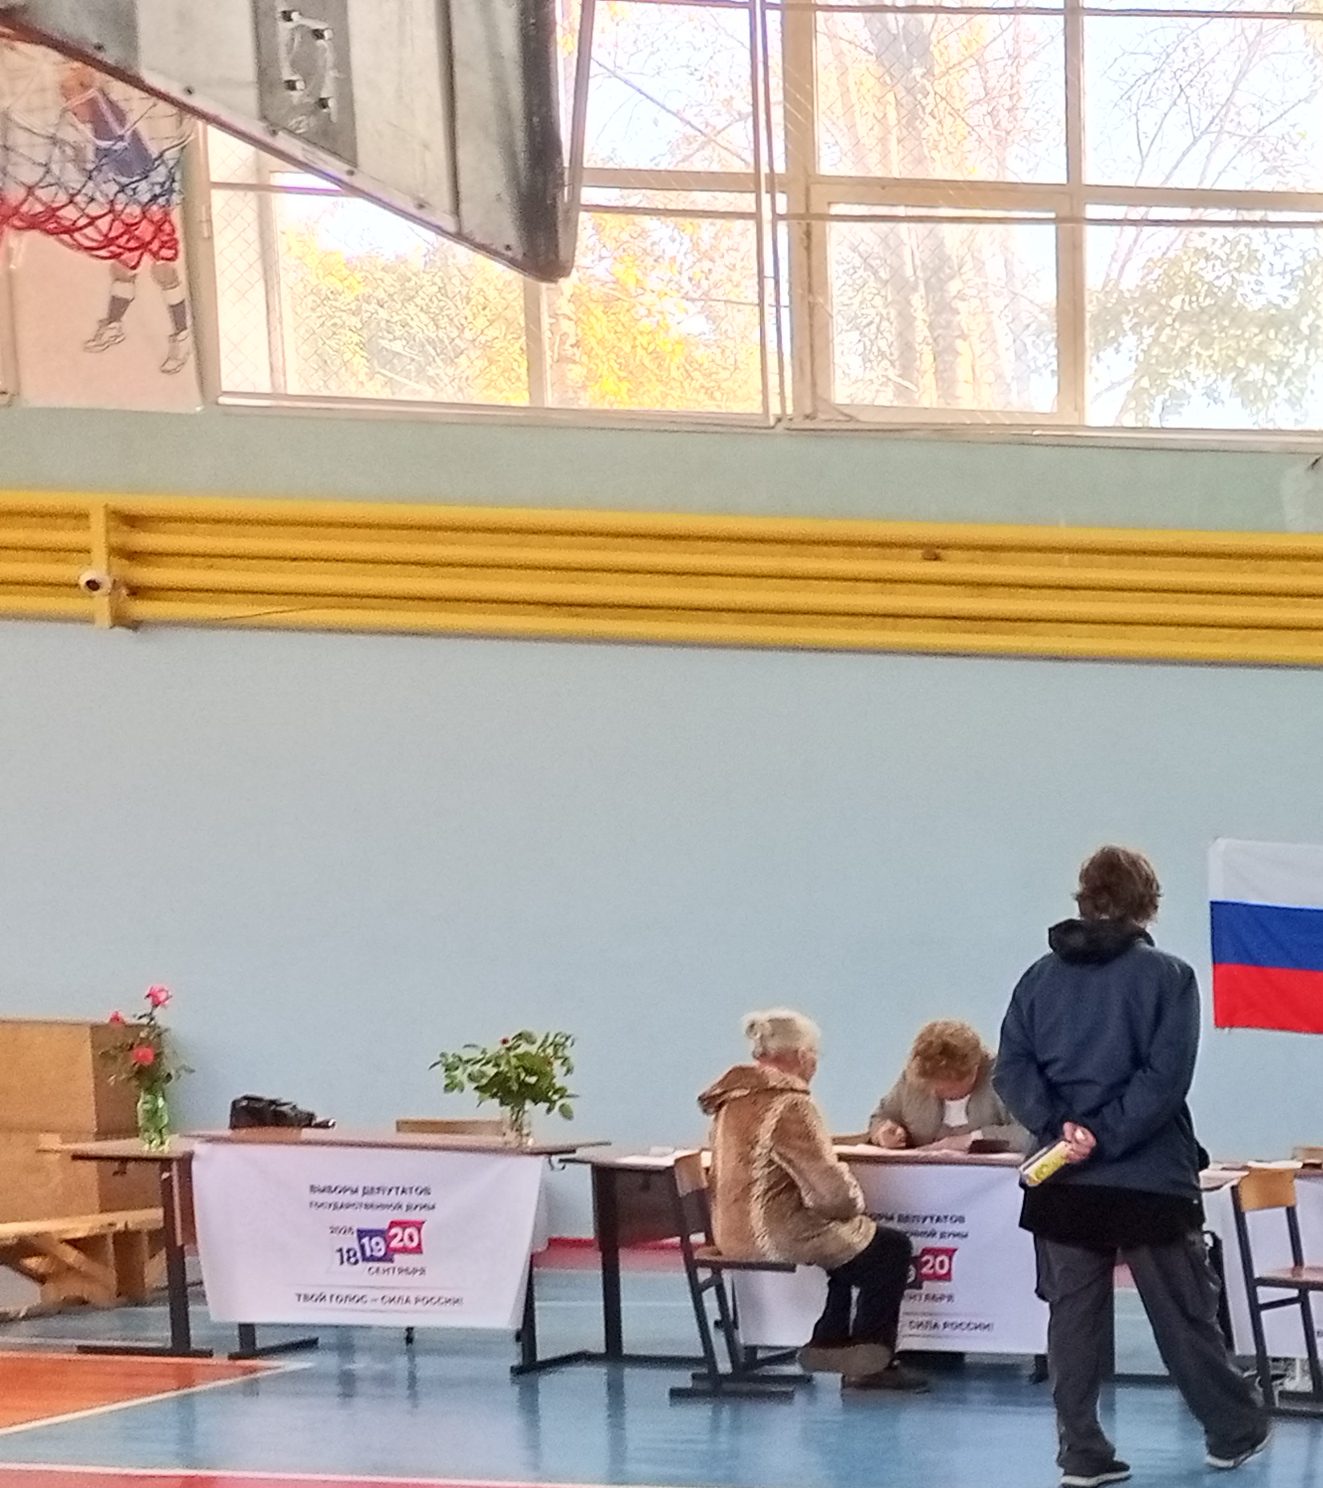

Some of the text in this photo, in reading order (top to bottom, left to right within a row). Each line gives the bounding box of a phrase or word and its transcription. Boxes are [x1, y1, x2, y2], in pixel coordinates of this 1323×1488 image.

[336, 1226, 420, 1266] 18 19 20
[920, 1255, 950, 1275] 20
